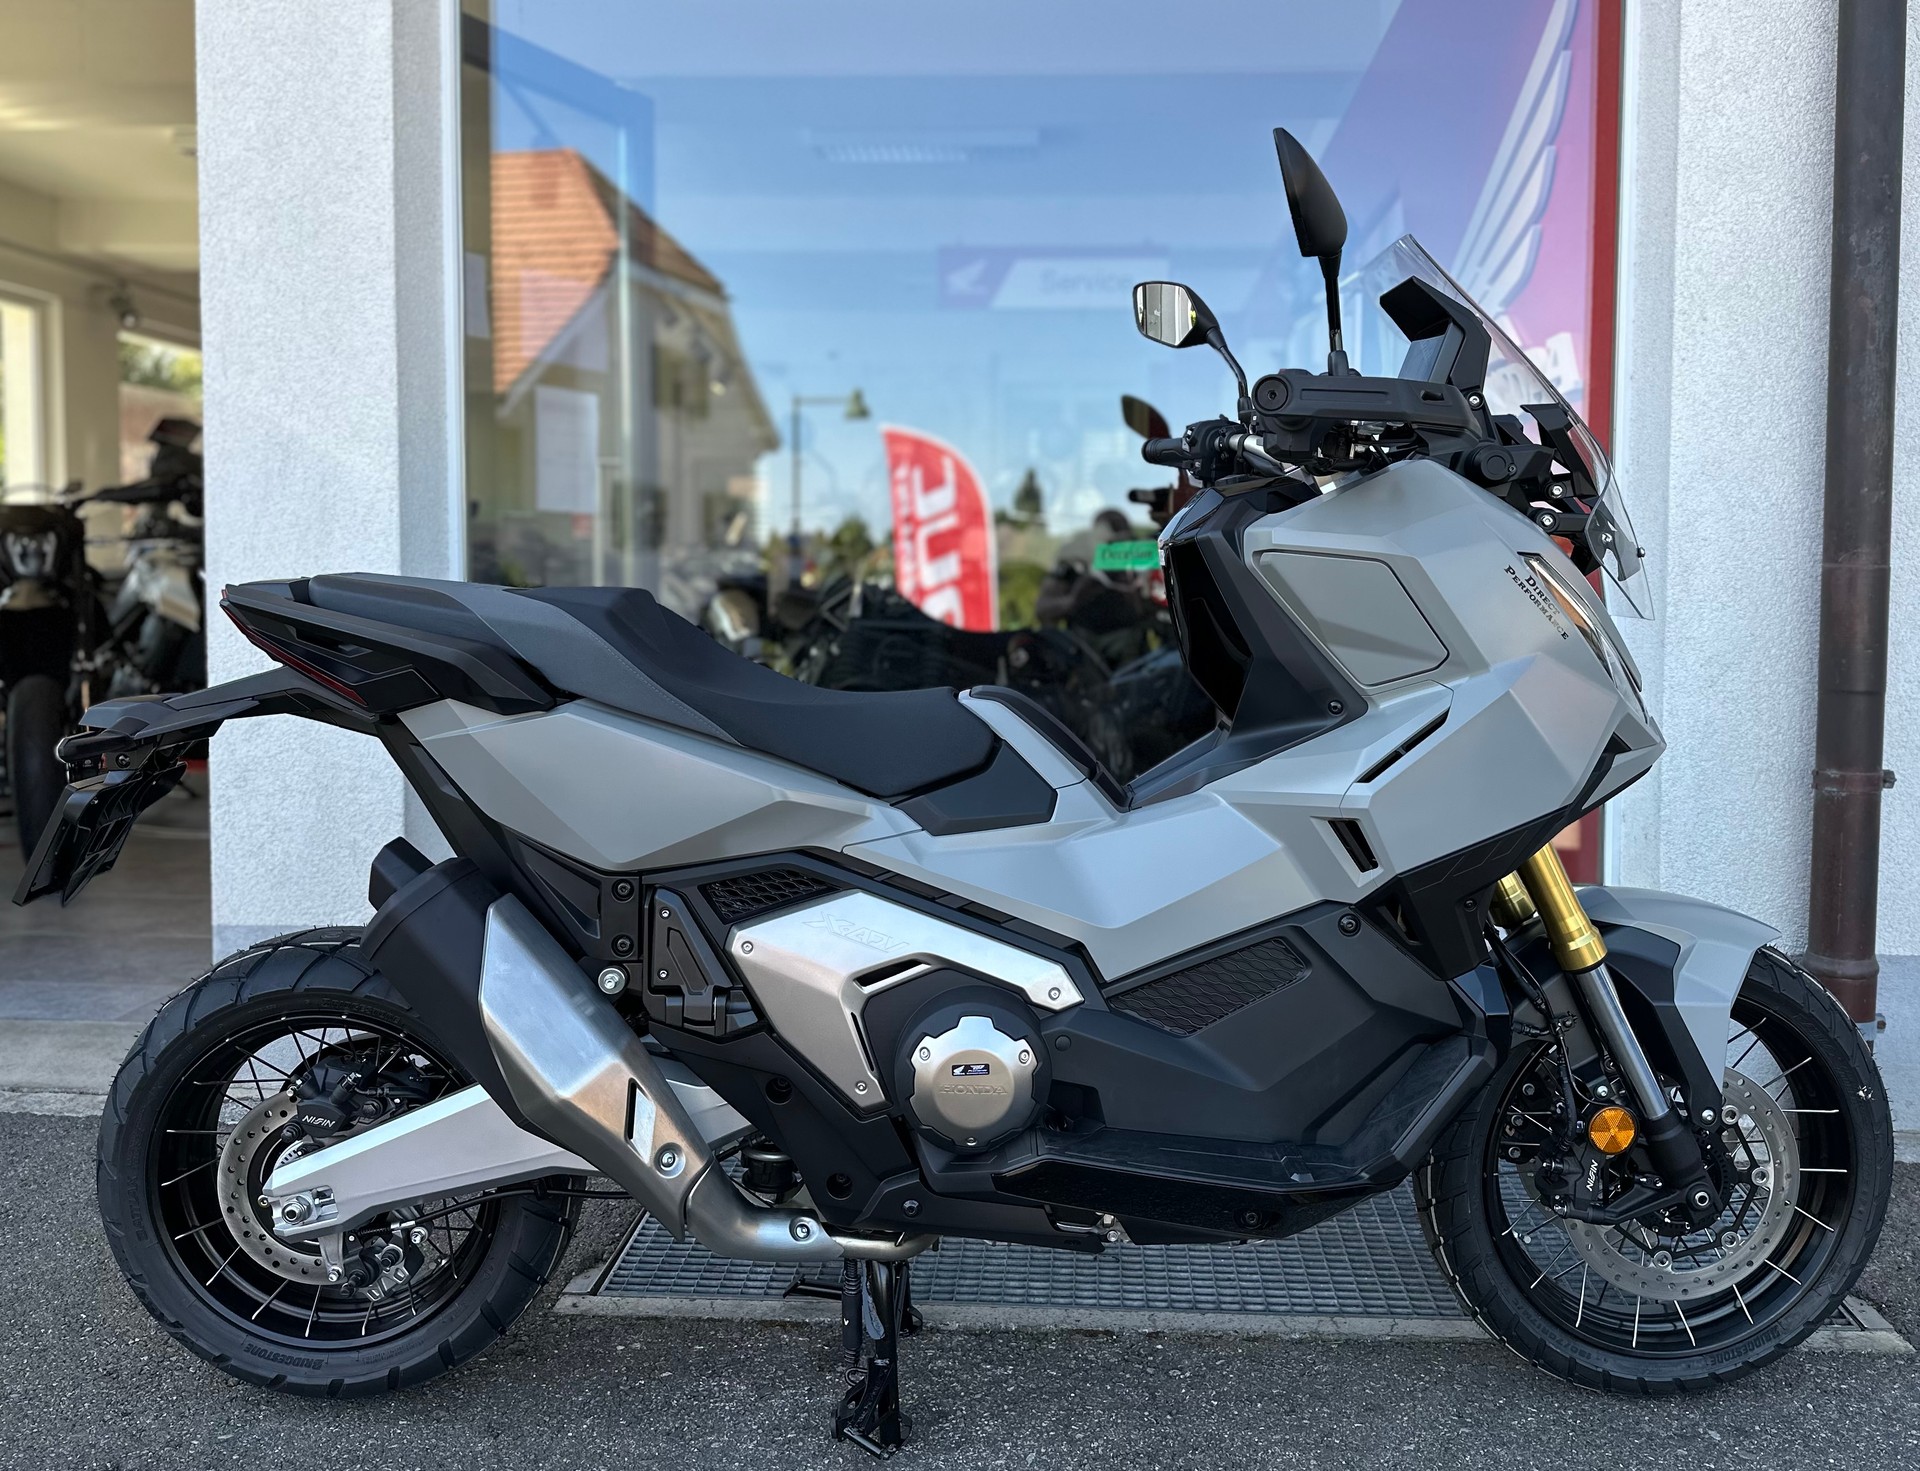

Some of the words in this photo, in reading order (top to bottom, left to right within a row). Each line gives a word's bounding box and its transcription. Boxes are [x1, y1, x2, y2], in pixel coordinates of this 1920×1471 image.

[1504, 565, 1569, 640] PERFORMANCE
[1525, 575, 1560, 615] DIRECT
[939, 1084, 1008, 1095] HONDA
[243, 1342, 324, 1371] BRIDGESTONE
[1709, 1324, 1782, 1367] BRIDGESTONE
